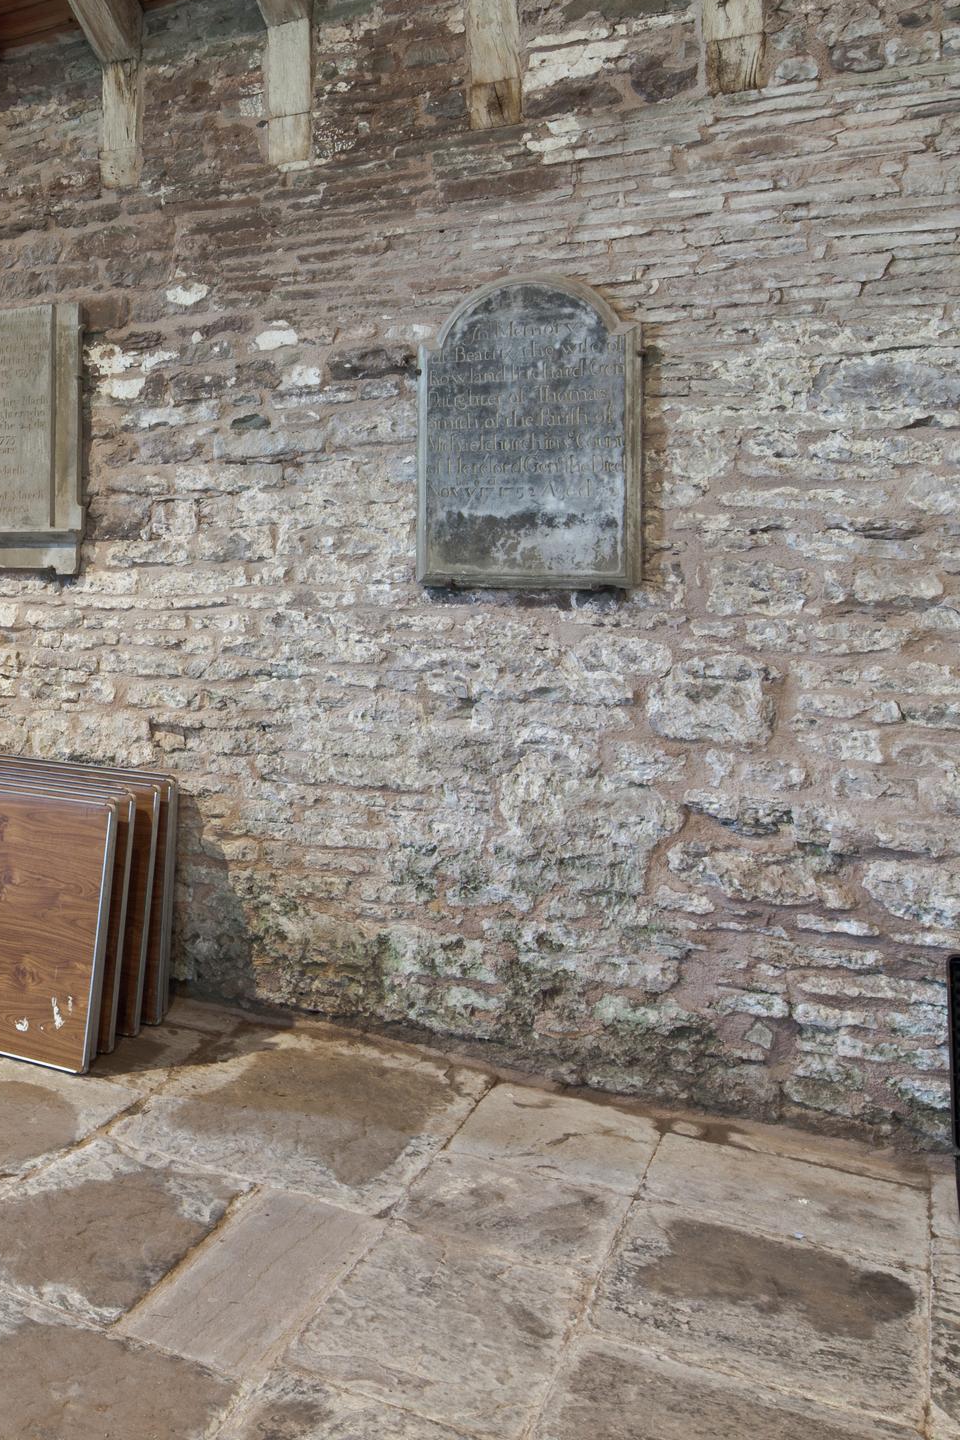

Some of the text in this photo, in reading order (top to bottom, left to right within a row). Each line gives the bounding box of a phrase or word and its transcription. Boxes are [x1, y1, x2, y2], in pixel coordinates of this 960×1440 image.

[495, 320, 581, 340] Memory
[455, 346, 516, 364] Beatrix
[520, 339, 555, 359] the
[558, 337, 603, 355] wife
[606, 335, 623, 352] of
[429, 365, 507, 387] Rowland
[428, 385, 608, 410] Daughter of Thomas
[483, 411, 501, 429] of
[505, 409, 534, 428] the
[594, 400, 614, 424] of
[446, 455, 523, 475] Hereford
[591, 454, 627, 474] Died
[540, 478, 592, 501] Aged
